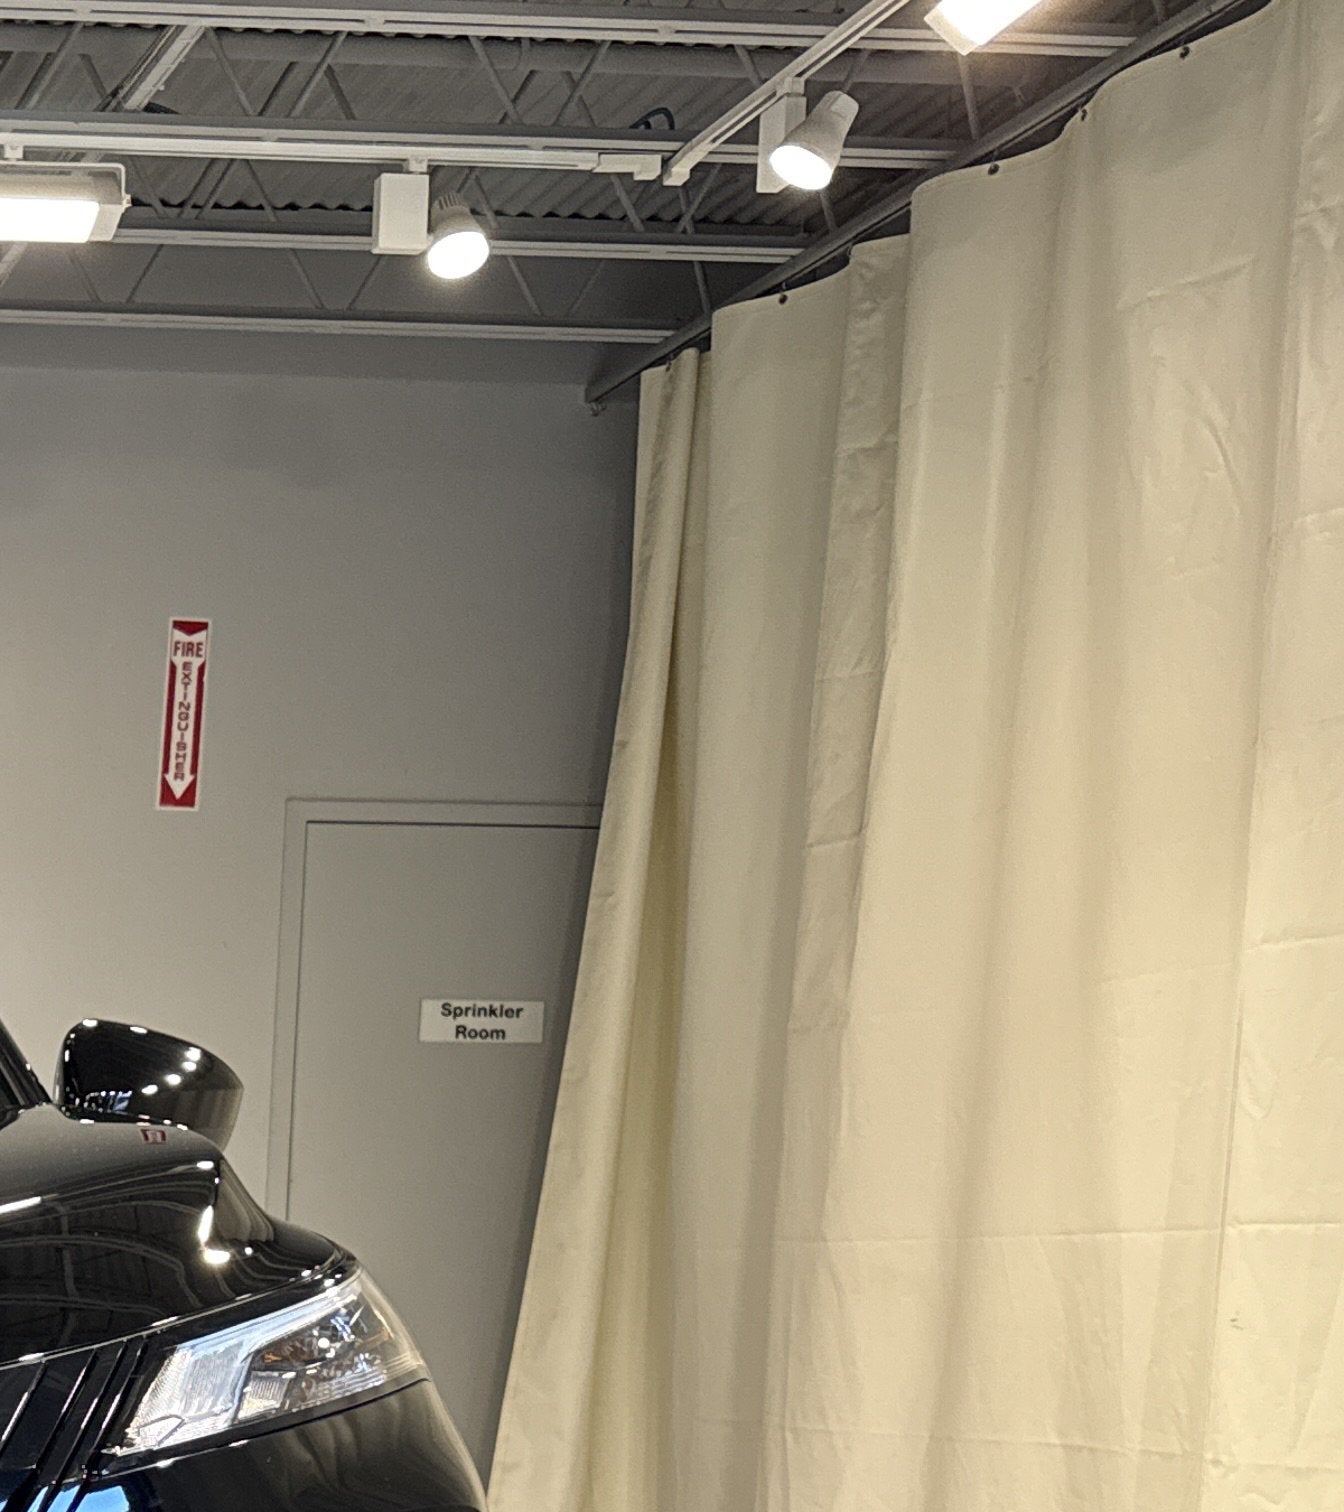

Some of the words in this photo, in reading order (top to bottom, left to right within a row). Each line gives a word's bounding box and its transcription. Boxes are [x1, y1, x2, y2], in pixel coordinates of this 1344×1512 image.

[173, 641, 204, 658] FIRE
[174, 661, 193, 781] EXTINGUISHER
[441, 1002, 523, 1020] Sprinkler
[455, 1024, 506, 1040] Room
